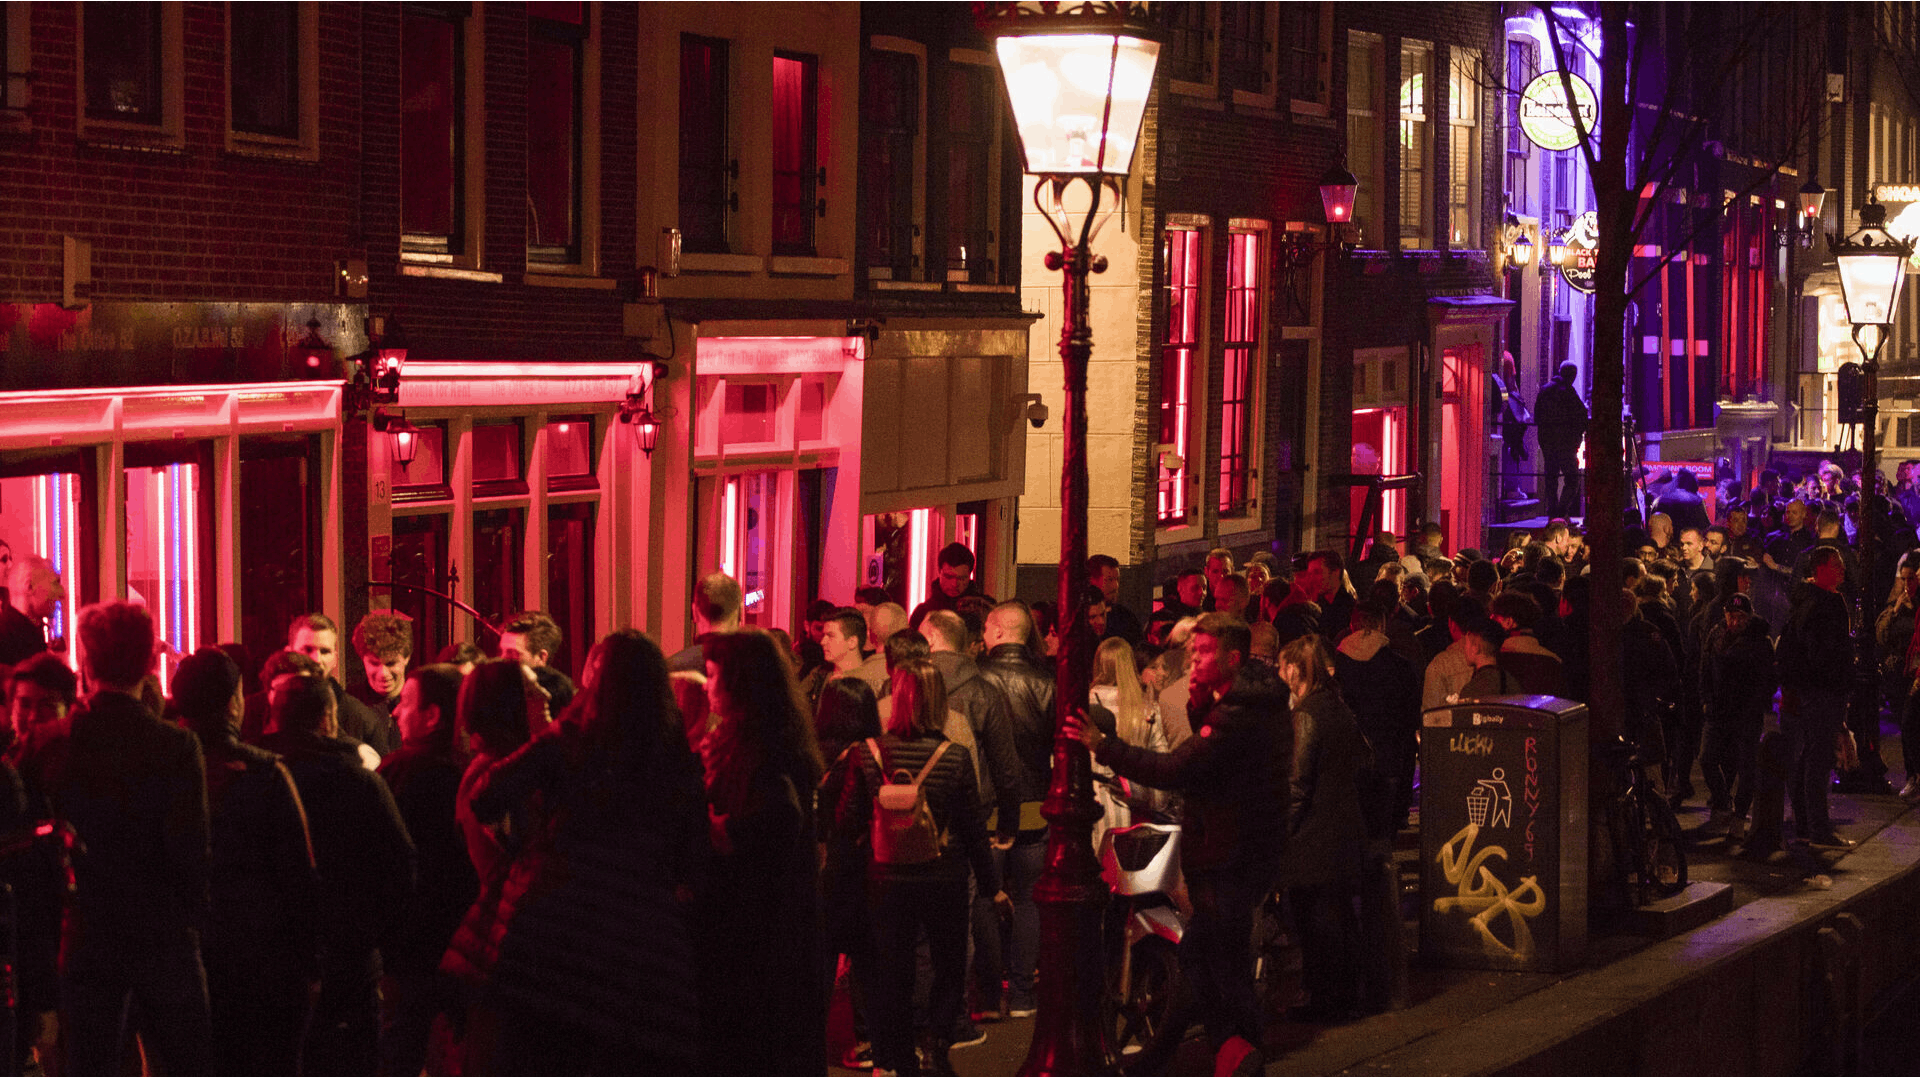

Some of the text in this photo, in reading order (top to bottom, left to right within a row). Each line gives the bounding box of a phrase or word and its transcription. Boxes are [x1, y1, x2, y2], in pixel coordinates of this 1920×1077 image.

[1566, 248, 1592, 256] BLACK
[1577, 256, 1597, 268] BA
[1685, 465, 1712, 473] ROOM
[376, 480, 386, 498] 13
